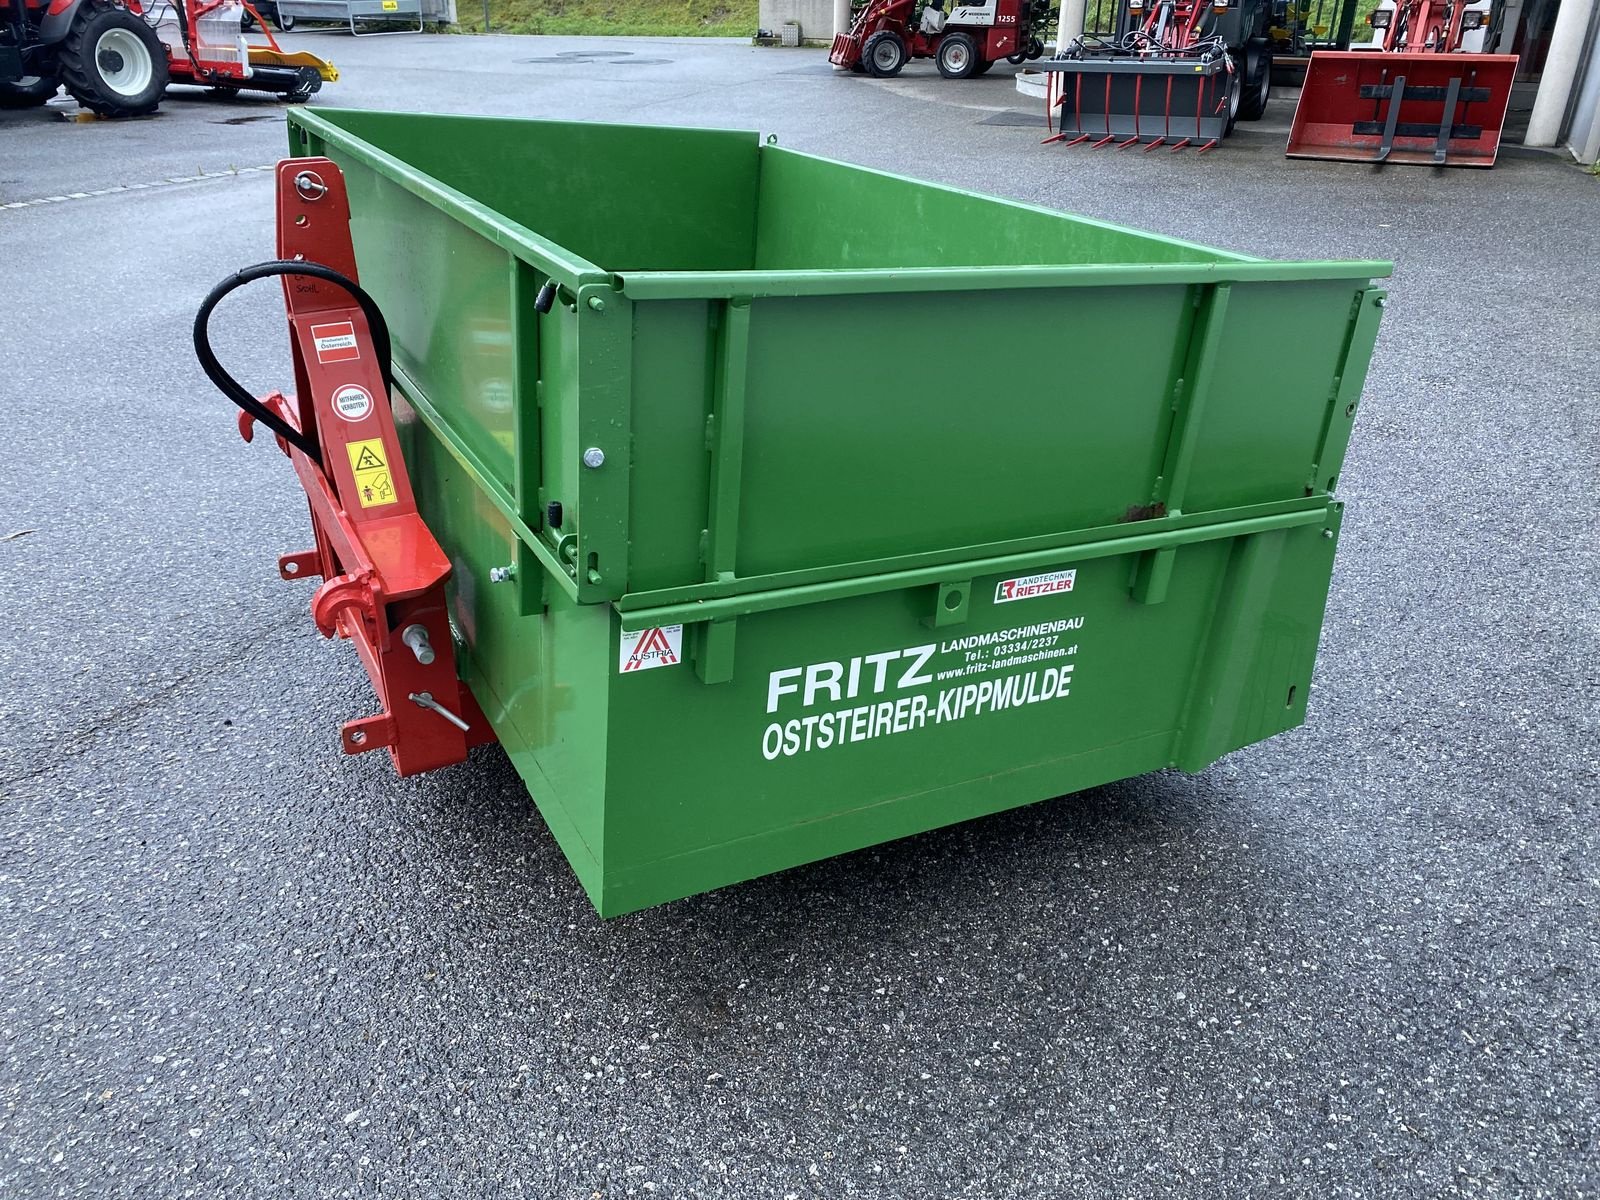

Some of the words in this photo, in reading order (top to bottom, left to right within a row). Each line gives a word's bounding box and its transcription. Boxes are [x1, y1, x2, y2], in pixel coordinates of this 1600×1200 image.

[997, 15, 1016, 23] 1255
[320, 341, 353, 350] Österreich
[339, 393, 365, 403] MITFAHREN
[341, 401, 365, 411] VERBOTEN
[1017, 571, 1073, 587] LANDTECHNIK
[1015, 579, 1073, 598] RIETZLER
[941, 616, 1084, 654] LANDMASCHINENBAU
[629, 649, 674, 661] AUSTRIA
[965, 648, 989, 662] Tel.:
[993, 635, 1059, 656] 03334/2237
[937, 644, 1078, 681] www.fritz-landmaschinen.at
[766, 643, 937, 714] FRITZ
[762, 664, 1075, 760] OSTSTEIRER-KIPPMULDE
